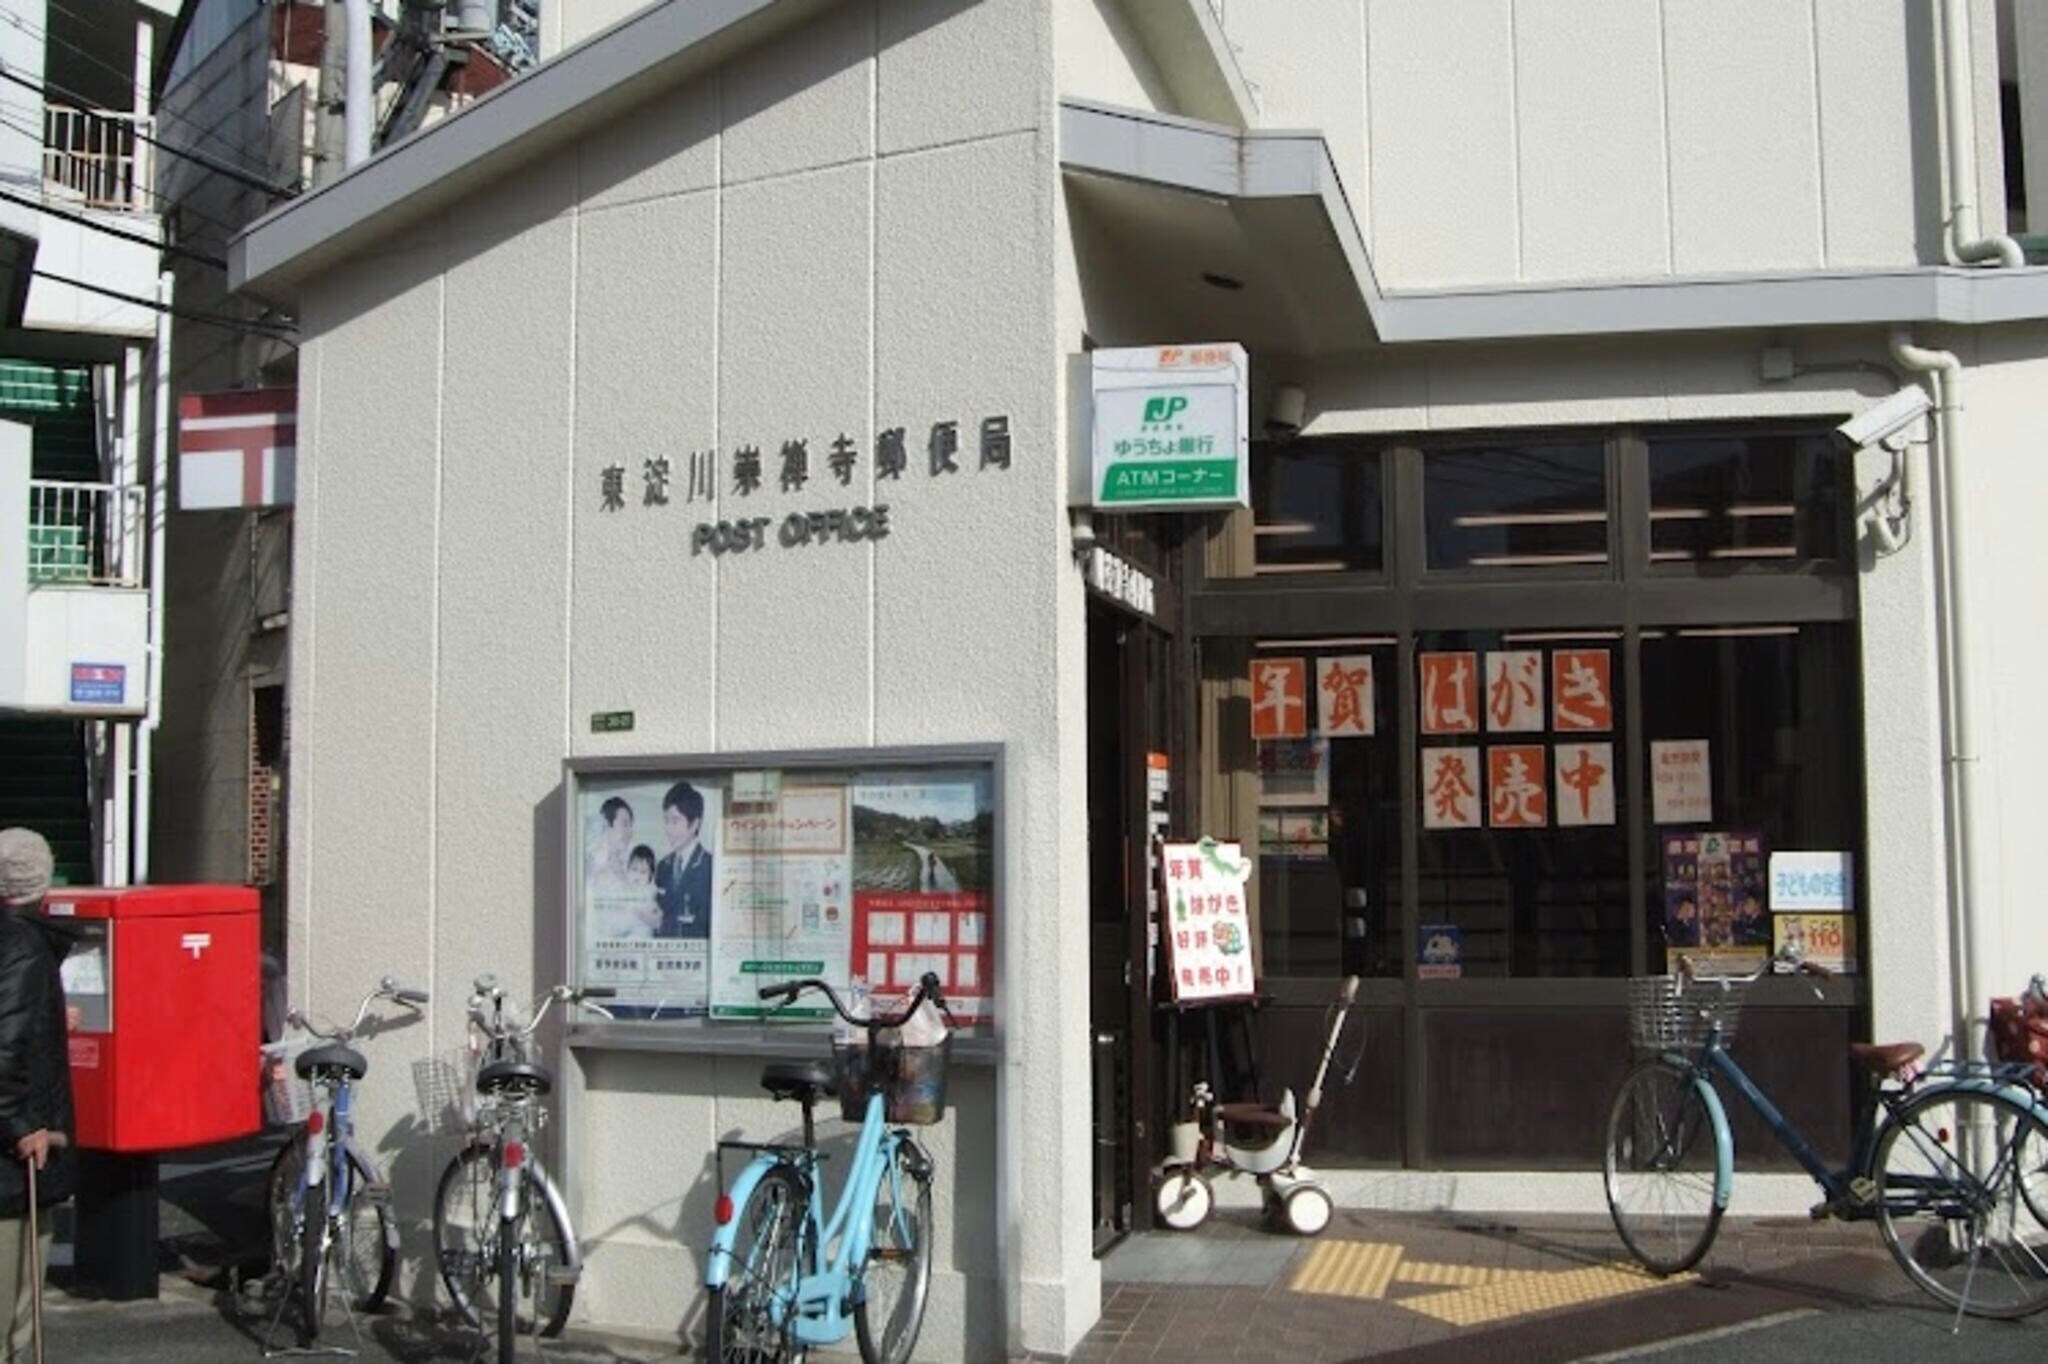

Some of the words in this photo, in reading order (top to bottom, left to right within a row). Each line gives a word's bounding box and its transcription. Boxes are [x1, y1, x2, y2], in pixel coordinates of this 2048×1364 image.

[1114, 435, 1214, 457] ゆうちょ銀行
[1116, 468, 1223, 486] ATMコーナー
[691, 517, 771, 557] POST
[778, 505, 890, 548] OFFICE
[1254, 663, 1367, 735] 年賀
[1426, 656, 1606, 730] はがき
[1429, 749, 1604, 823] 発売中
[1169, 859, 1203, 880] 年賀
[1190, 894, 1240, 915] はがき
[1809, 930, 1842, 947] 110
